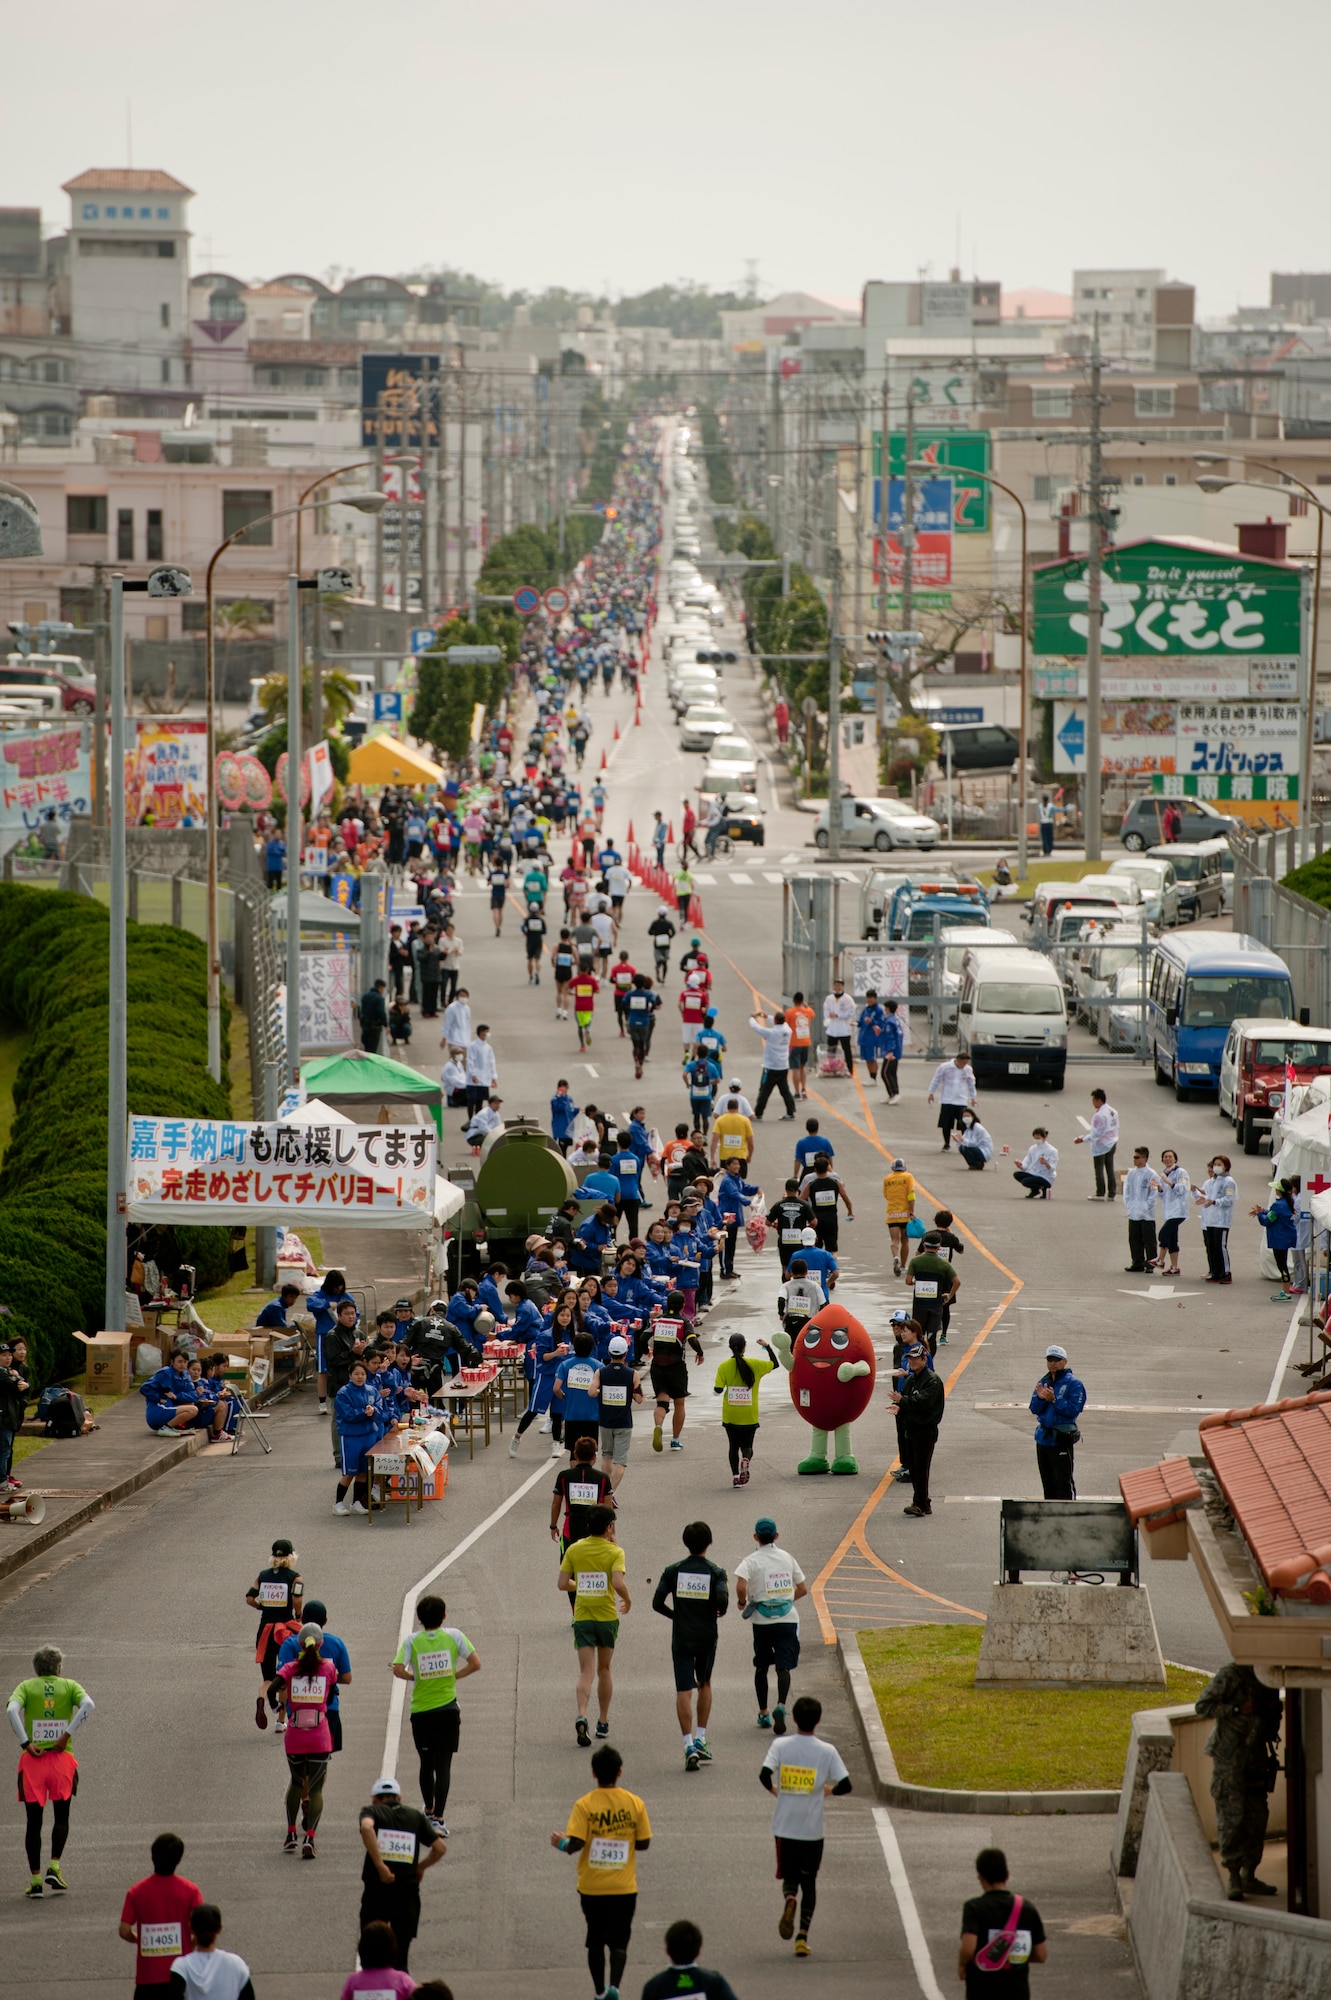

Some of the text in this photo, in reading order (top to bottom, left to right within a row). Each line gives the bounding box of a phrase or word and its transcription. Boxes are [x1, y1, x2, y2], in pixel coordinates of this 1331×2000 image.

[1064, 568, 1265, 651] さくもと
[1180, 704, 1298, 721] 使用済自動車引取所
[1191, 742, 1283, 772] スーパーハウス
[1163, 776, 1288, 800] 翔南病院
[131, 1121, 435, 1166] 嘉手納町も応援してます
[161, 1168, 403, 1206] 完走めざしてチバリヨー!
[660, 1328, 675, 1337] 5395
[574, 1375, 591, 1384] 4099
[608, 1391, 624, 1400] 2585
[577, 1490, 594, 1498] 3131
[587, 1580, 605, 1589] 2160
[686, 1582, 707, 1591] 5656
[774, 1579, 791, 1588] 6109
[267, 1591, 285, 1600] 1647
[428, 1659, 449, 1671] 2107
[788, 1775, 815, 1786] 12100
[389, 1840, 412, 1852] 3644
[601, 1849, 625, 1860] 5433
[150, 1933, 179, 1946] 14051
